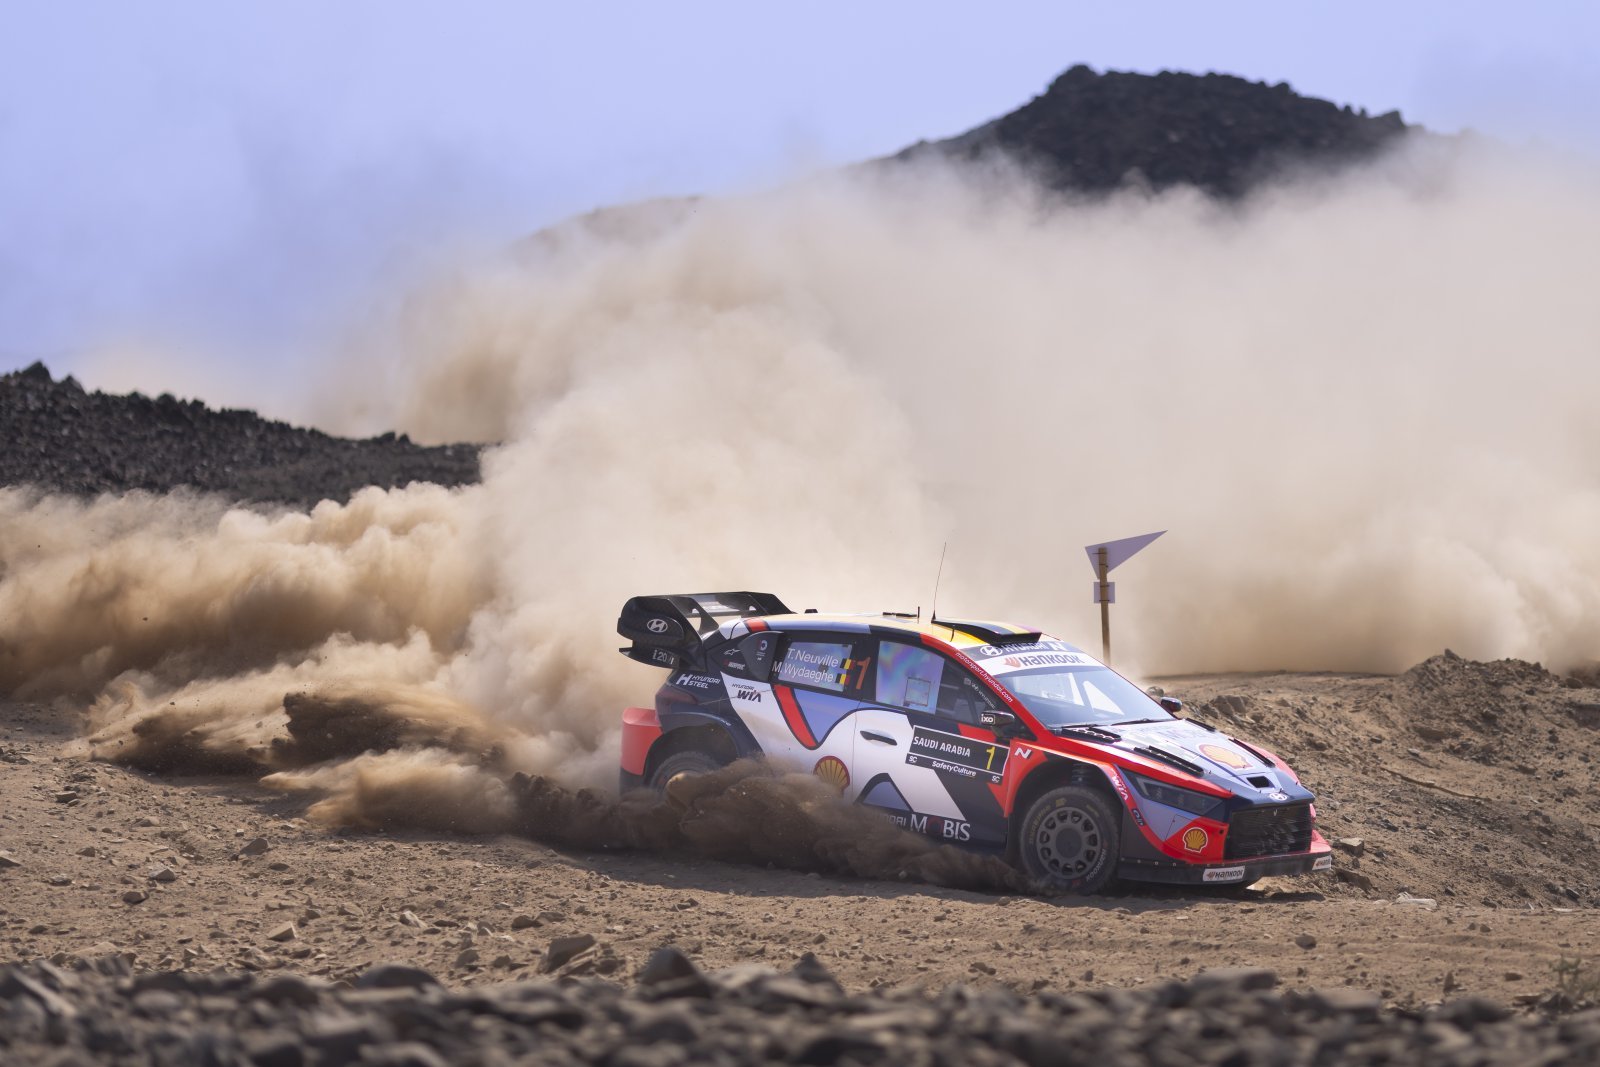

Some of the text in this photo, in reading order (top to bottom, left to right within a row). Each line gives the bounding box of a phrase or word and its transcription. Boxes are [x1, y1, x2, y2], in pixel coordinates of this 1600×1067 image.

[692, 674, 720, 685] HYUNDAI
[857, 656, 871, 690] 1
[688, 680, 709, 689] STEEL
[913, 736, 971, 758] SAUDI ARABIA
[986, 746, 996, 770] 1
[932, 760, 977, 777] SafetyCulture
[910, 813, 971, 841] MOBIS
